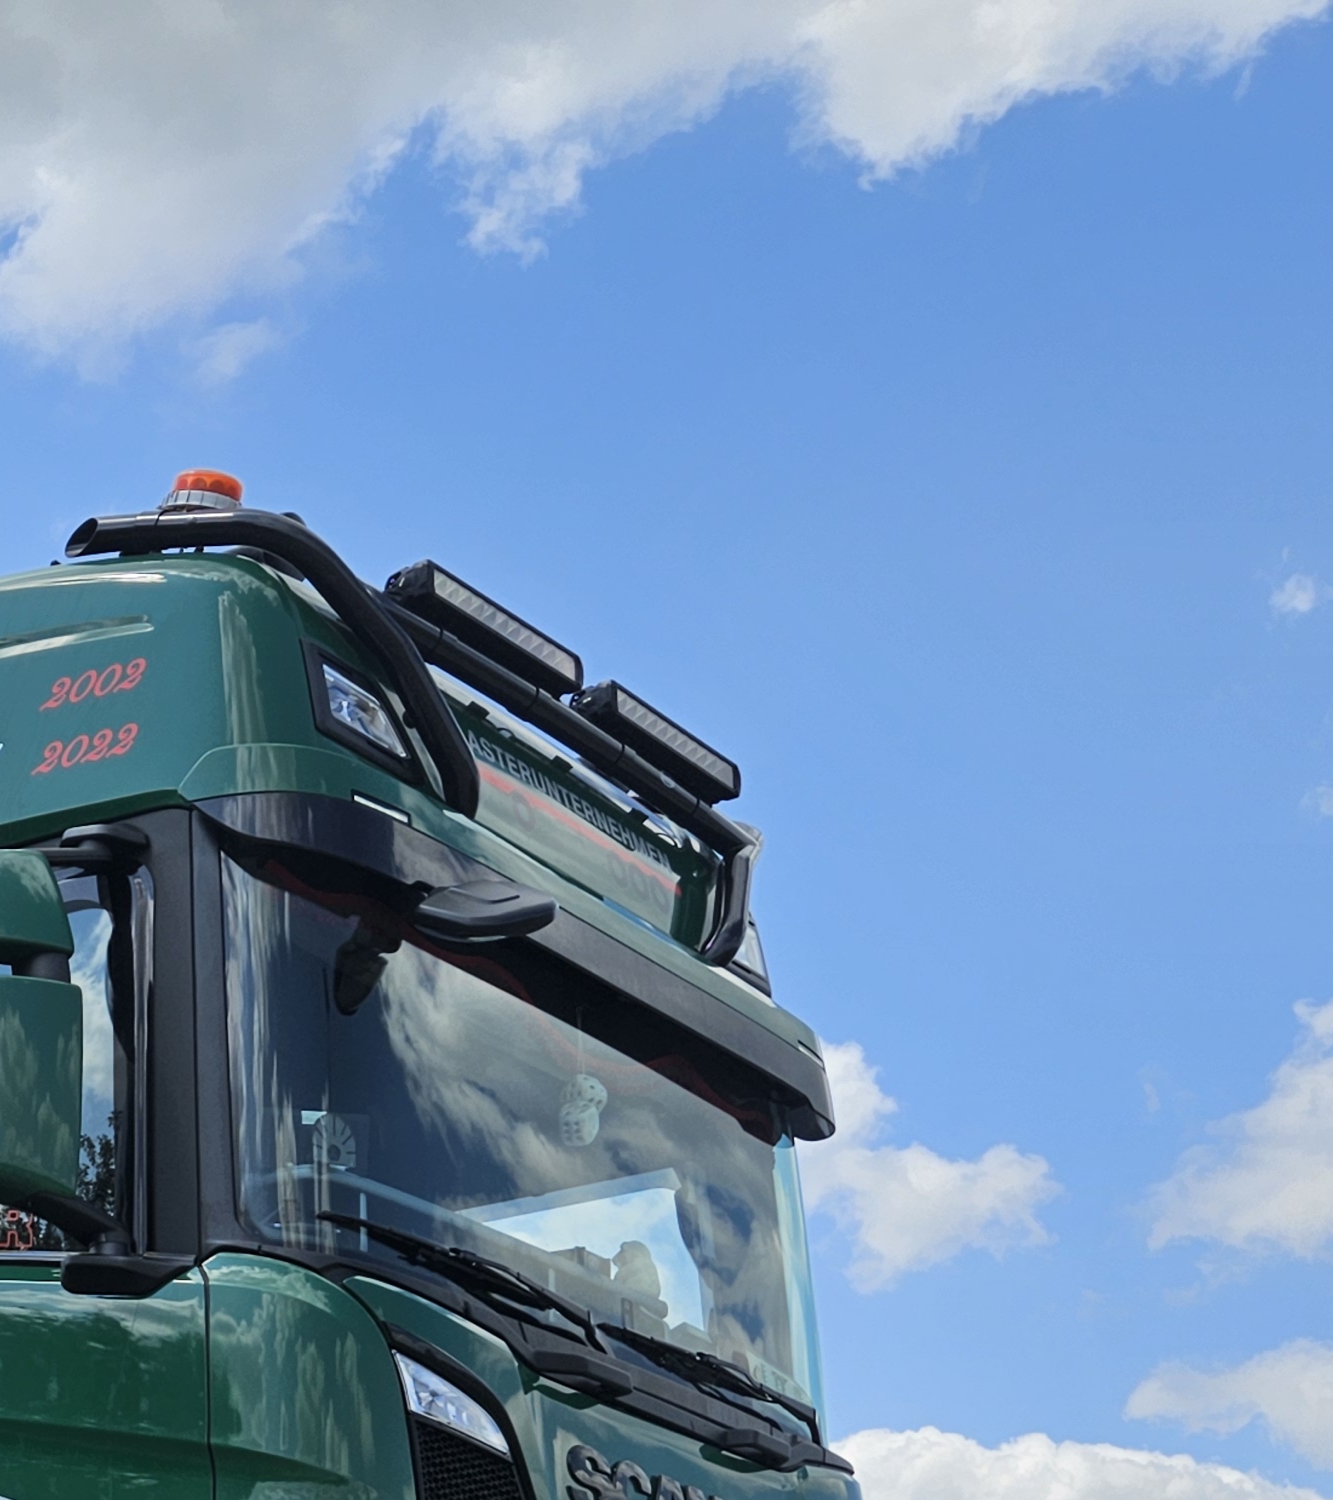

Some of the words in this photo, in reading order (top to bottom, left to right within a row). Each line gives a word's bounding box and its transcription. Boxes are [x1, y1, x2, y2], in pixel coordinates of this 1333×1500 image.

[39, 657, 148, 712] 2002
[31, 723, 140, 777] 2022
[467, 729, 673, 871] ASTERUNTERNEHMEN
